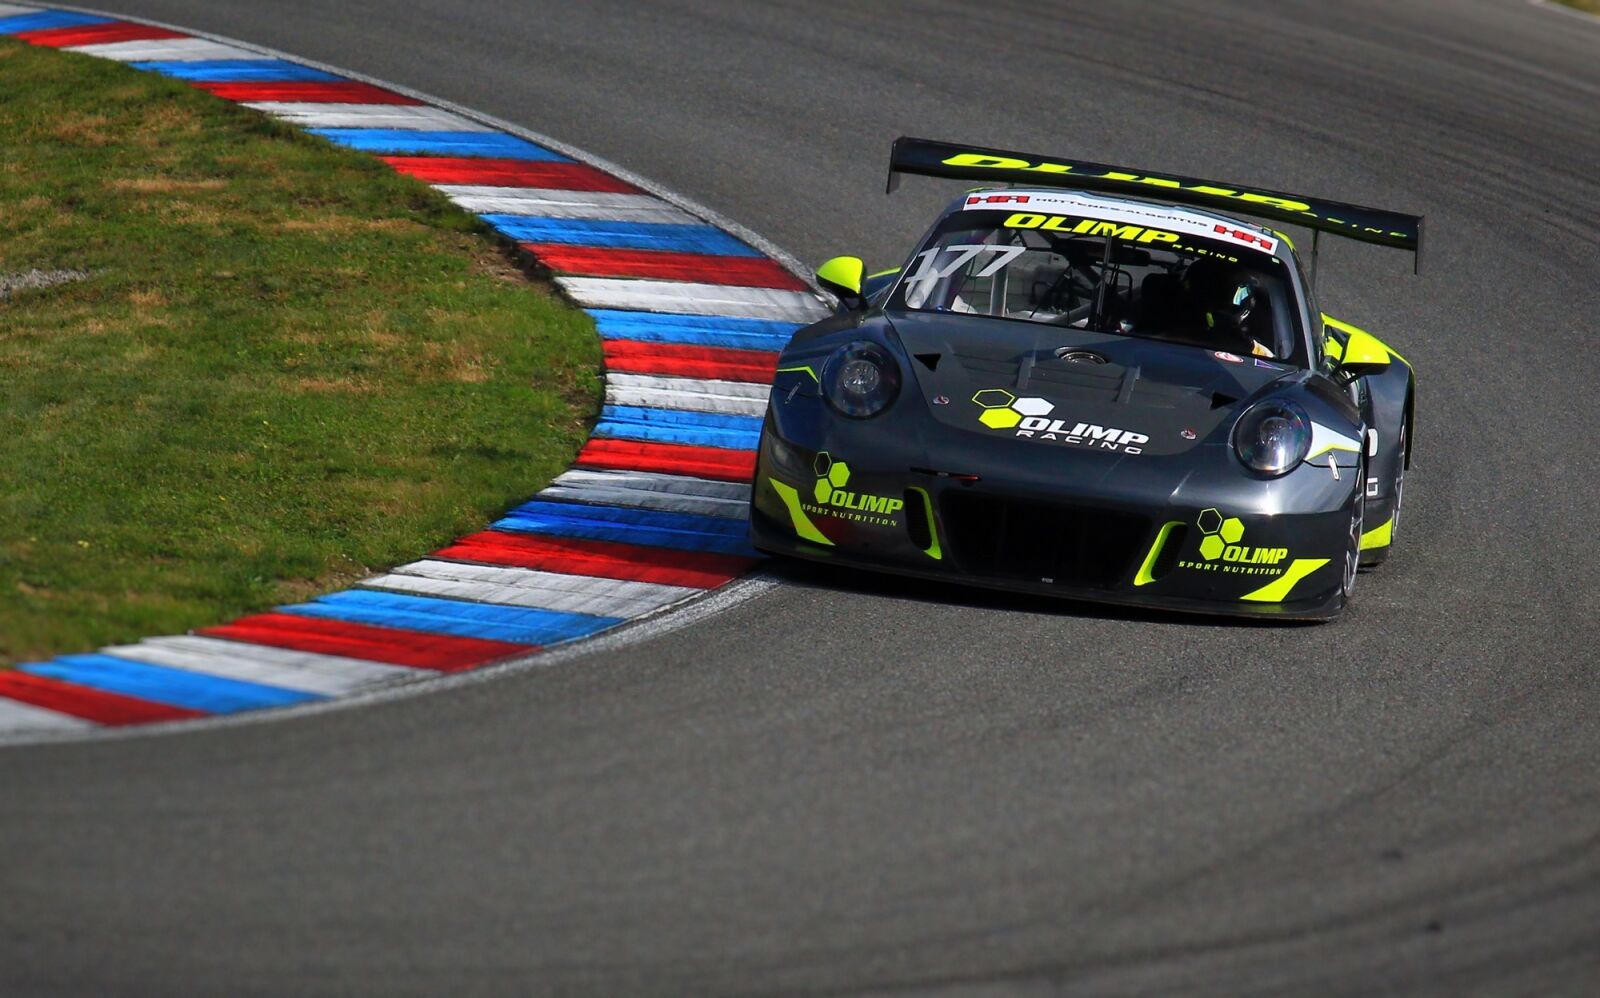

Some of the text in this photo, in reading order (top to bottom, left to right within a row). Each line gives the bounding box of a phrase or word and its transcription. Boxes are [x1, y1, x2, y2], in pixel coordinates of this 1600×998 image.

[1003, 213, 1239, 263] OLIMP RACING
[904, 244, 1027, 284] 177
[1015, 430, 1143, 455] RACING
[1018, 416, 1150, 445] OLIMP
[831, 489, 904, 515] OLIMP
[802, 503, 898, 527] SPORT NUTRITION
[1178, 560, 1283, 575] SPORT NUTRITION
[1222, 545, 1289, 565] OLIMP
